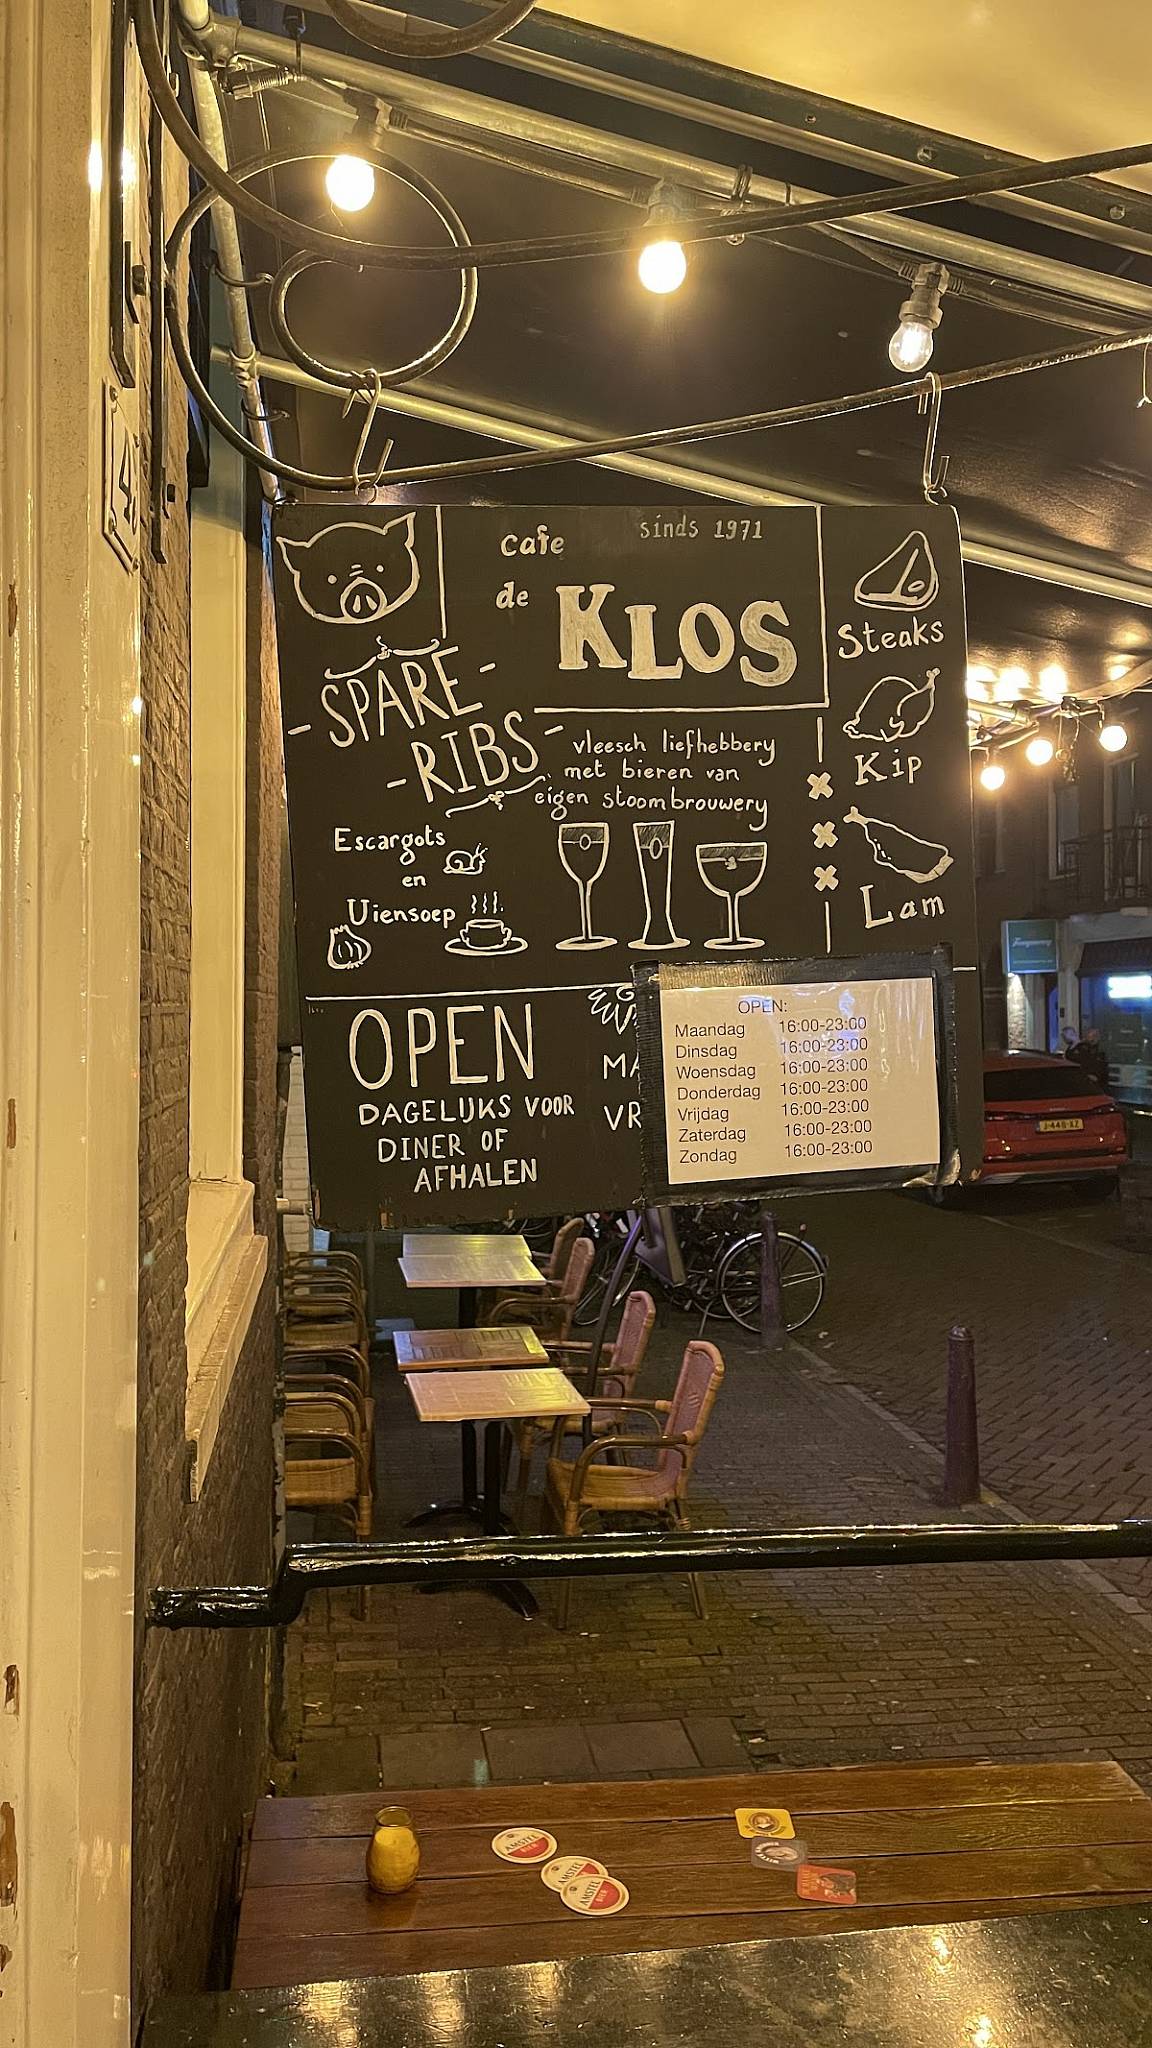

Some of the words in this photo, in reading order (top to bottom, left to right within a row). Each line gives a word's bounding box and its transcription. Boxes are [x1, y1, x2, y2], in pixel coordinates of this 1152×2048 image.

[640, 515, 699, 539] sinds
[714, 518, 763, 541] 1971
[495, 581, 530, 609] de
[555, 583, 798, 687] KLOS
[837, 616, 945, 659] Steaks
[320, 645, 484, 749] SPARE
[410, 710, 539, 803] RIBS
[573, 729, 647, 755] vleesch
[662, 729, 777, 766] liefhebbery
[564, 760, 606, 780] met
[622, 758, 694, 780] bieren
[706, 767, 740, 782] van
[853, 748, 922, 786] Kip
[534, 785, 589, 821] eigen
[602, 785, 769, 832] stoombrouwery
[334, 825, 446, 866] Escargots
[401, 873, 427, 888] en
[347, 898, 456, 928] Uiensoep
[859, 884, 945, 929] Lam
[737, 999, 788, 1015] OPEN:
[674, 1023, 746, 1041] Maandag
[779, 1017, 867, 1034] 16:00-23:00
[349, 1003, 534, 1090] OPEN
[675, 1044, 738, 1062] Dinsdag
[780, 1037, 869, 1054] 16:00-23:00
[676, 1064, 756, 1083] Woensdag
[780, 1058, 869, 1075] 16:00-23:00
[677, 1085, 761, 1102] Donderdag
[780, 1079, 869, 1096] 16:00-23:00
[524, 1094, 575, 1117] VOOR
[677, 1106, 730, 1124] Vrijdag
[781, 1099, 869, 1117] 16:00-23:00
[378, 1133, 465, 1163] DINER
[481, 1128, 509, 1152] OF
[678, 1127, 747, 1145] Zaterdag
[783, 1119, 872, 1137] 16:00-23:00
[679, 1148, 737, 1165] Zondag
[784, 1140, 873, 1158] 16:00-23:00
[413, 1159, 538, 1193] AFHALEN
[505, 1834, 539, 1852] AMSTEL
[558, 1862, 584, 1885] AMSTEL
[579, 1879, 601, 1906] AMSTEL
